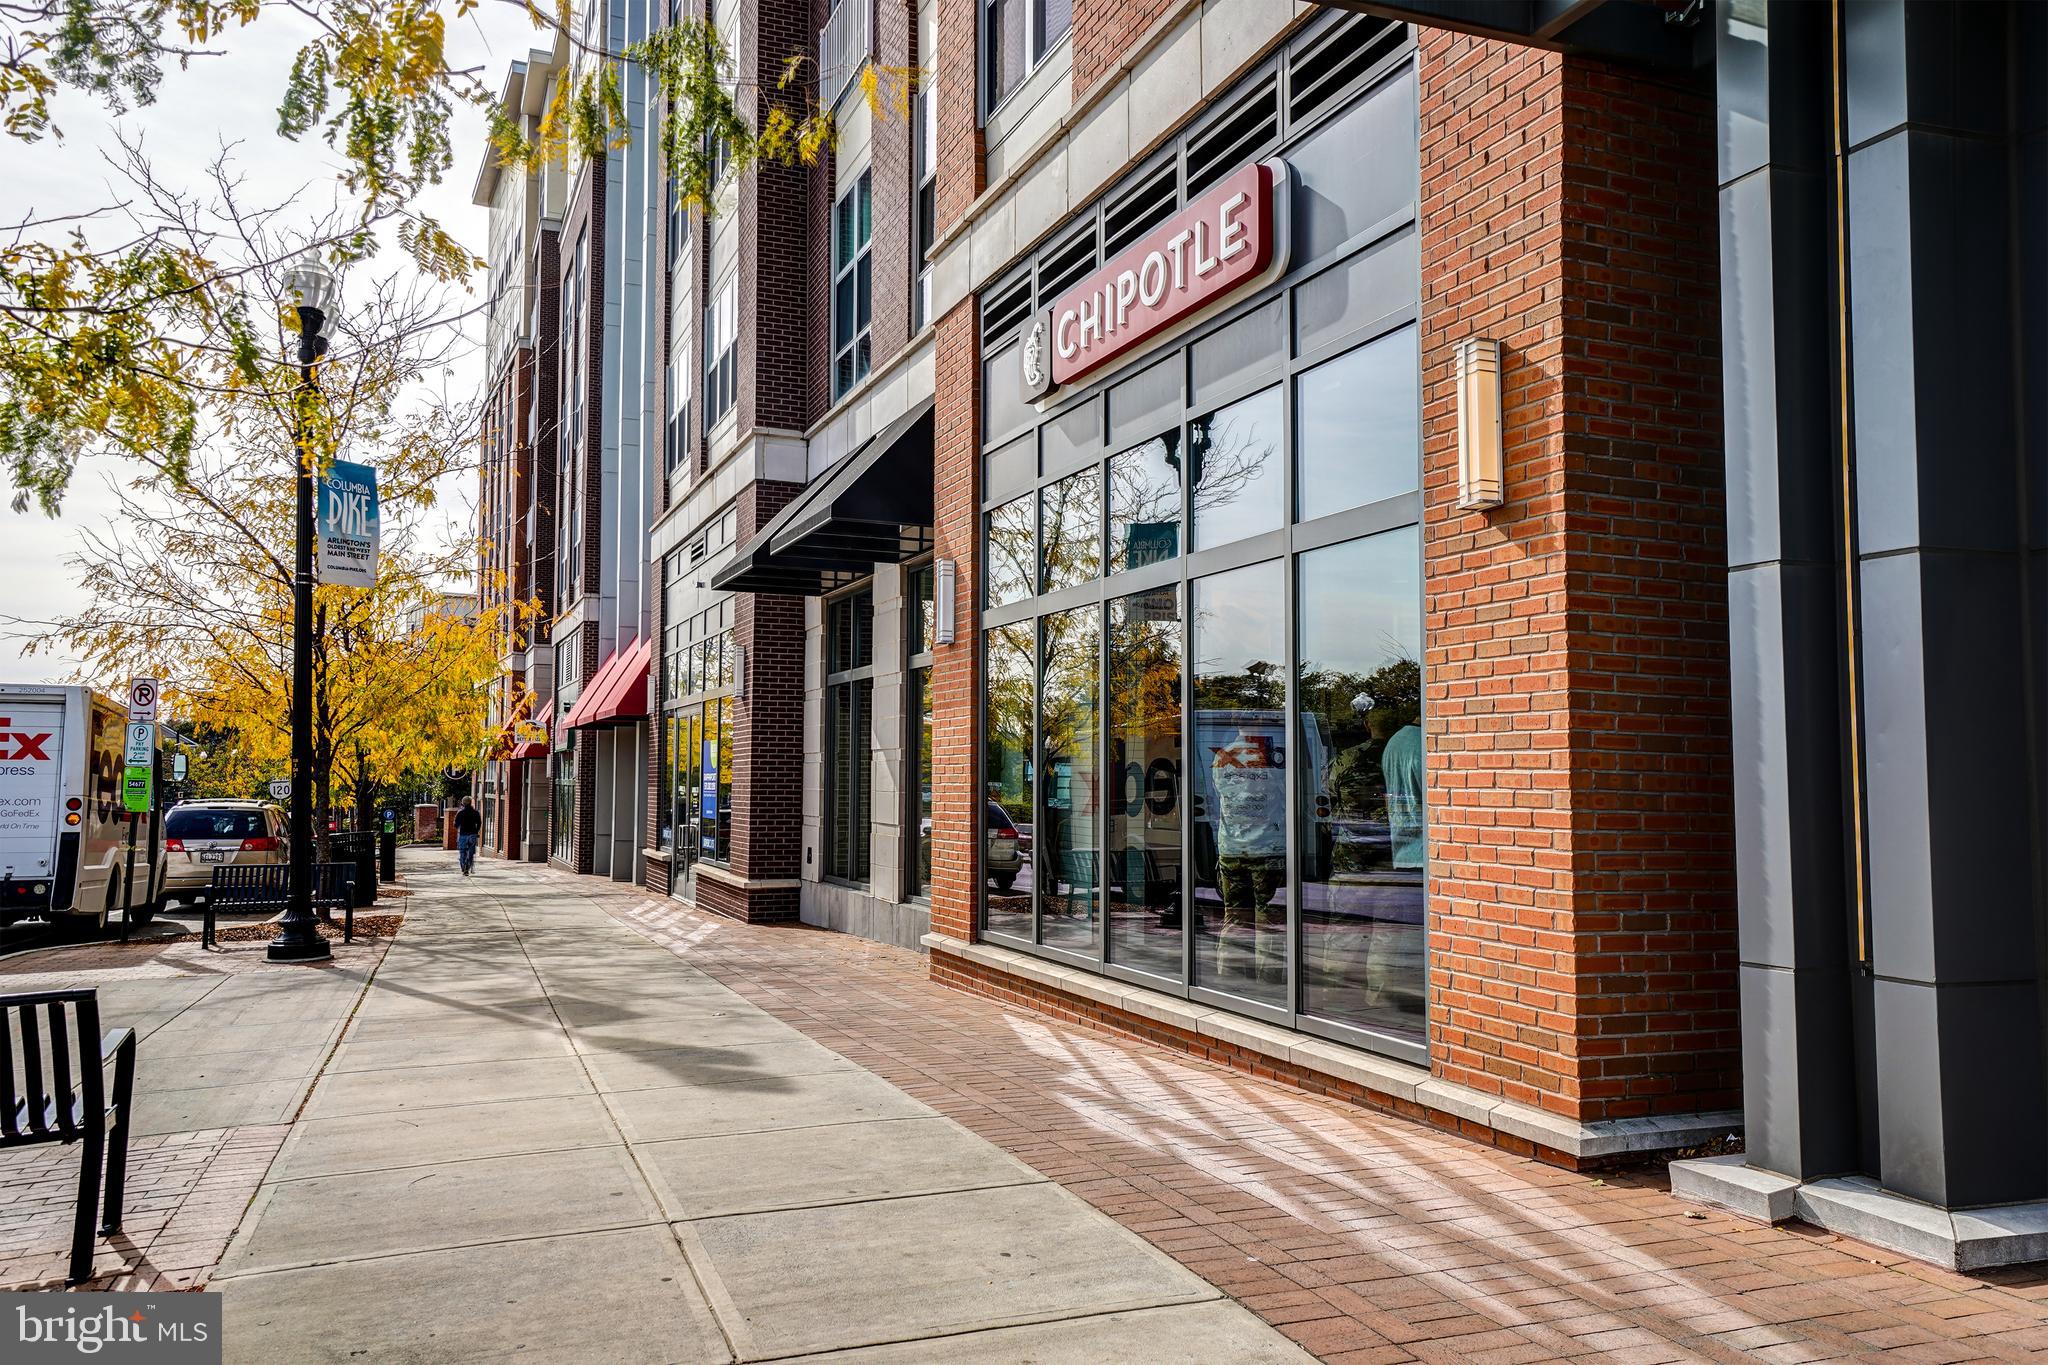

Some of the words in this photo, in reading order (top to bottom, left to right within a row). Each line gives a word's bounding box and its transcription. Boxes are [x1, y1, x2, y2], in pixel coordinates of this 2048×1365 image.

[1057, 191, 1248, 359] CHIPOTLE
[326, 478, 370, 495] COLUMBIA
[326, 489, 372, 537] PIKE
[327, 537, 371, 548] ARLINGTON'S
[327, 543, 346, 551] OLDEST
[327, 550, 346, 558] MAIN
[347, 551, 370, 561] STREET
[272, 785, 290, 795] 120
